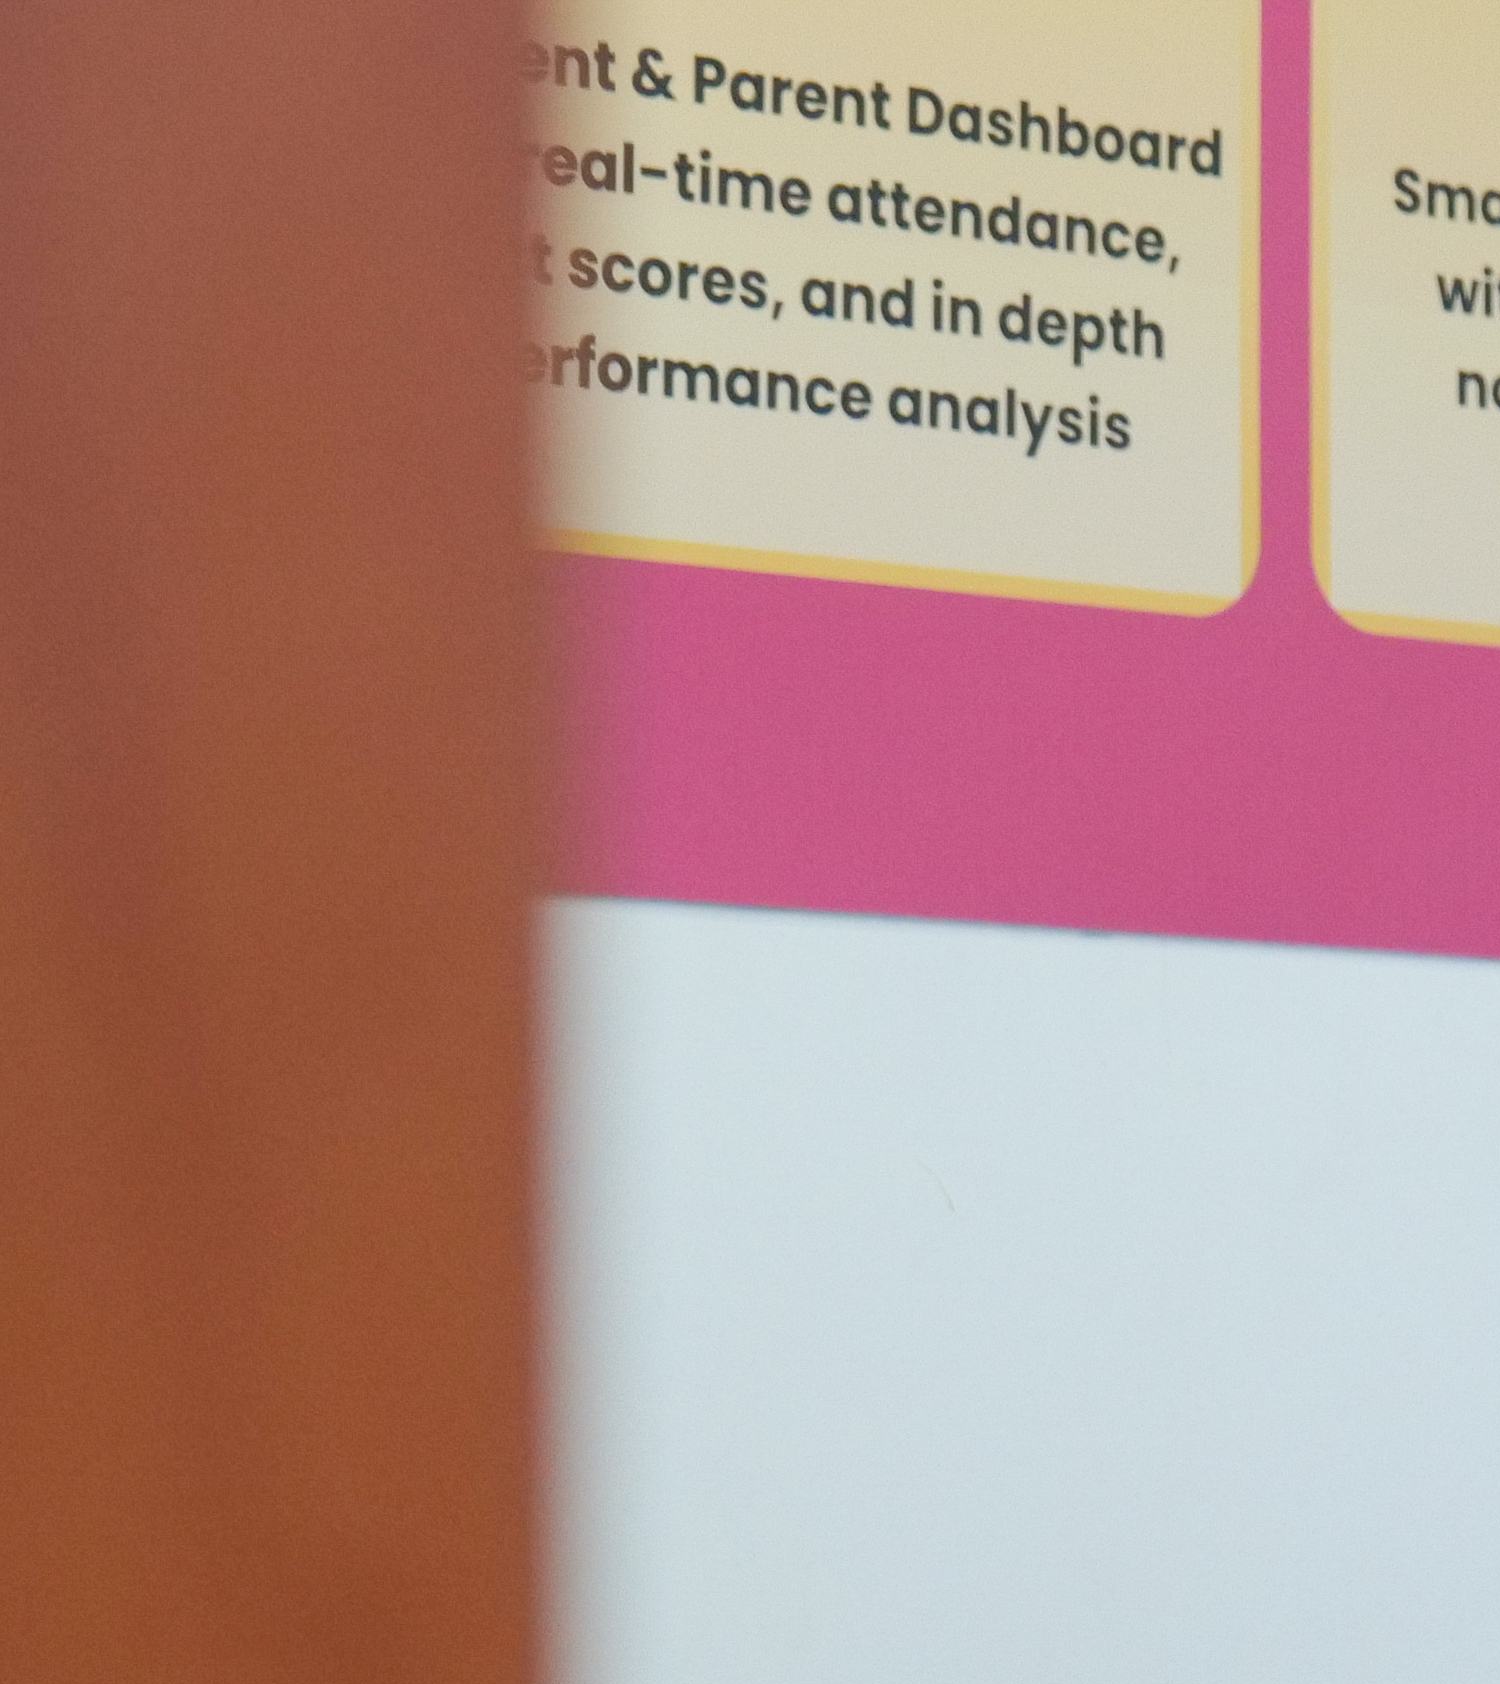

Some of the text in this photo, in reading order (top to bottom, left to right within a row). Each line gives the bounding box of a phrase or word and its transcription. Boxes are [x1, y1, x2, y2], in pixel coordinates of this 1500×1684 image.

[631, 46, 676, 102] &
[693, 53, 891, 132] Parent
[907, 84, 1223, 179] Dashboard
[826, 177, 1180, 275] attendance,
[569, 247, 784, 321] scores,
[800, 276, 915, 330] and
[932, 276, 982, 338] in
[997, 292, 1165, 366] depth
[887, 385, 1131, 459] analysis
